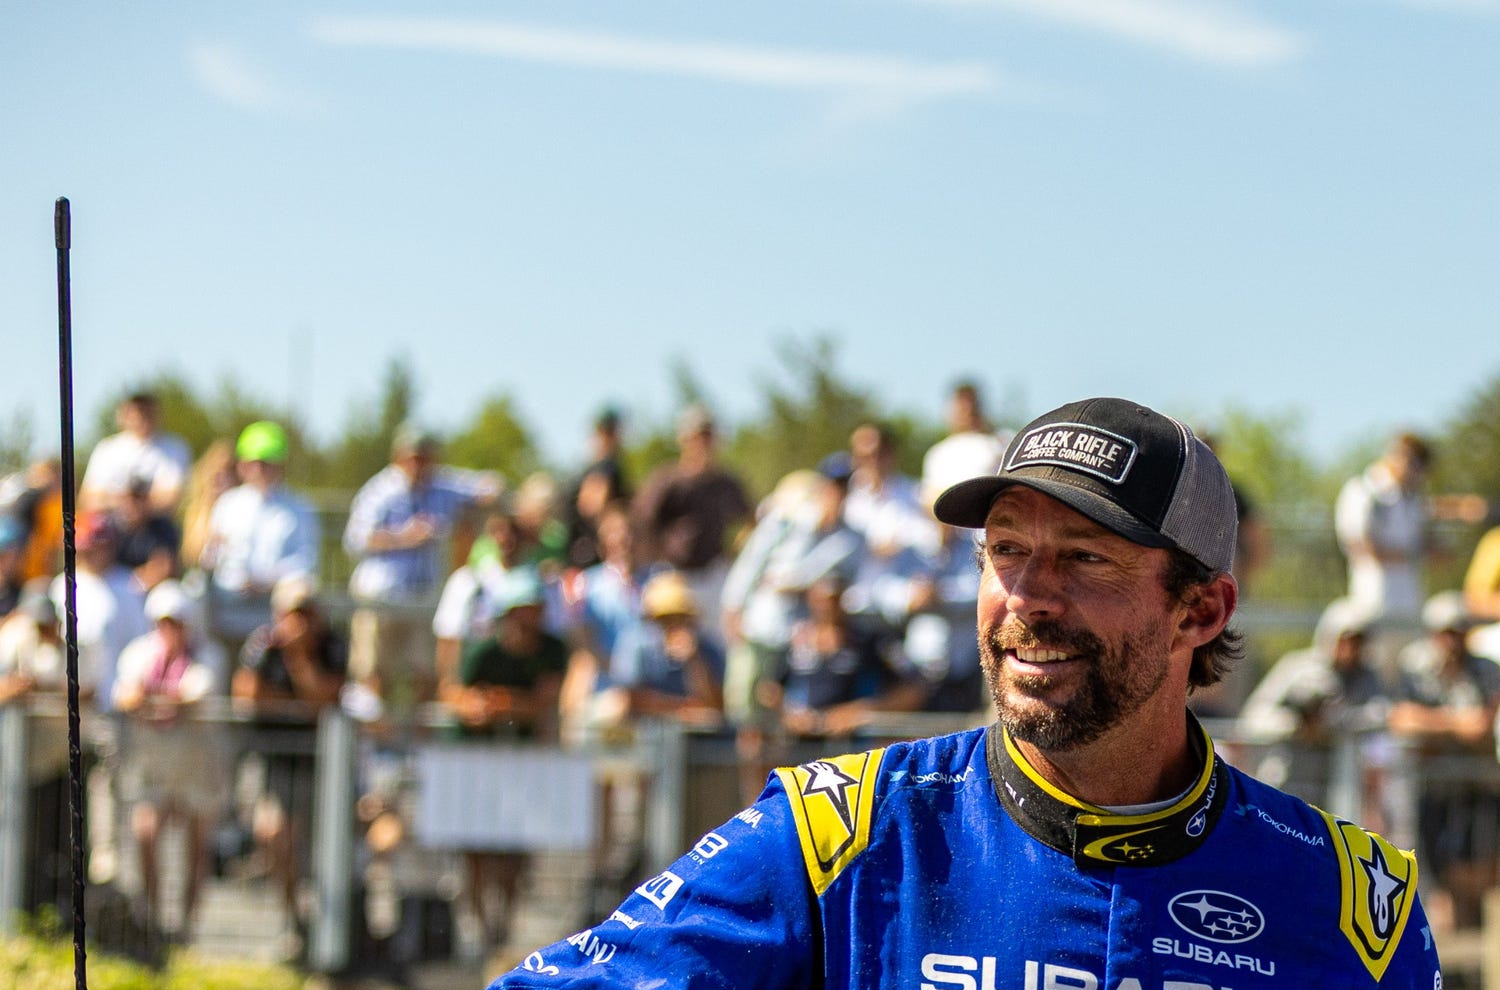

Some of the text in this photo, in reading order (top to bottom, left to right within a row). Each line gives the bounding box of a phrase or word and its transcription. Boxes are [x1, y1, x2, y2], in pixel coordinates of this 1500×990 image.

[1023, 430, 1122, 462] BLACK RIFLE
[1026, 446, 1106, 469] COFFEE COMPANY
[1257, 808, 1325, 847] YOKOHAMA
[1151, 937, 1276, 977] SUBARU
